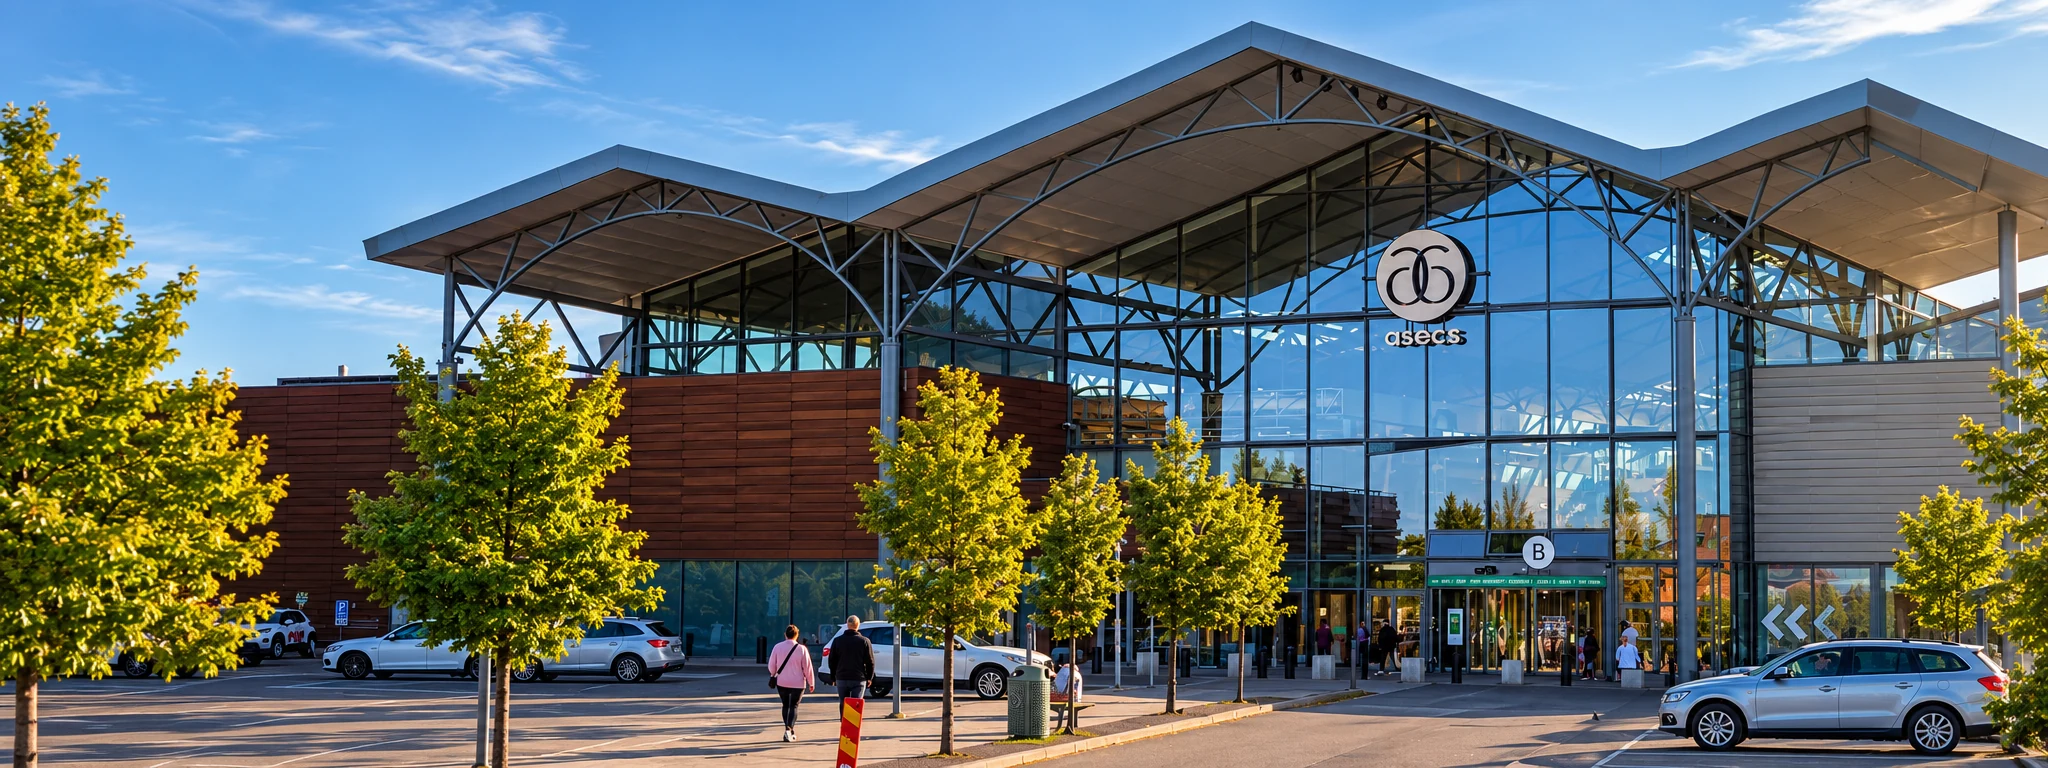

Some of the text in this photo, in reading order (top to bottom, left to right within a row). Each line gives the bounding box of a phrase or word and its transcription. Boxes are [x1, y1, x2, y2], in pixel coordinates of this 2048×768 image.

[1385, 328, 1461, 346] asecs
[1532, 543, 1545, 561] B
[338, 602, 346, 612] P
